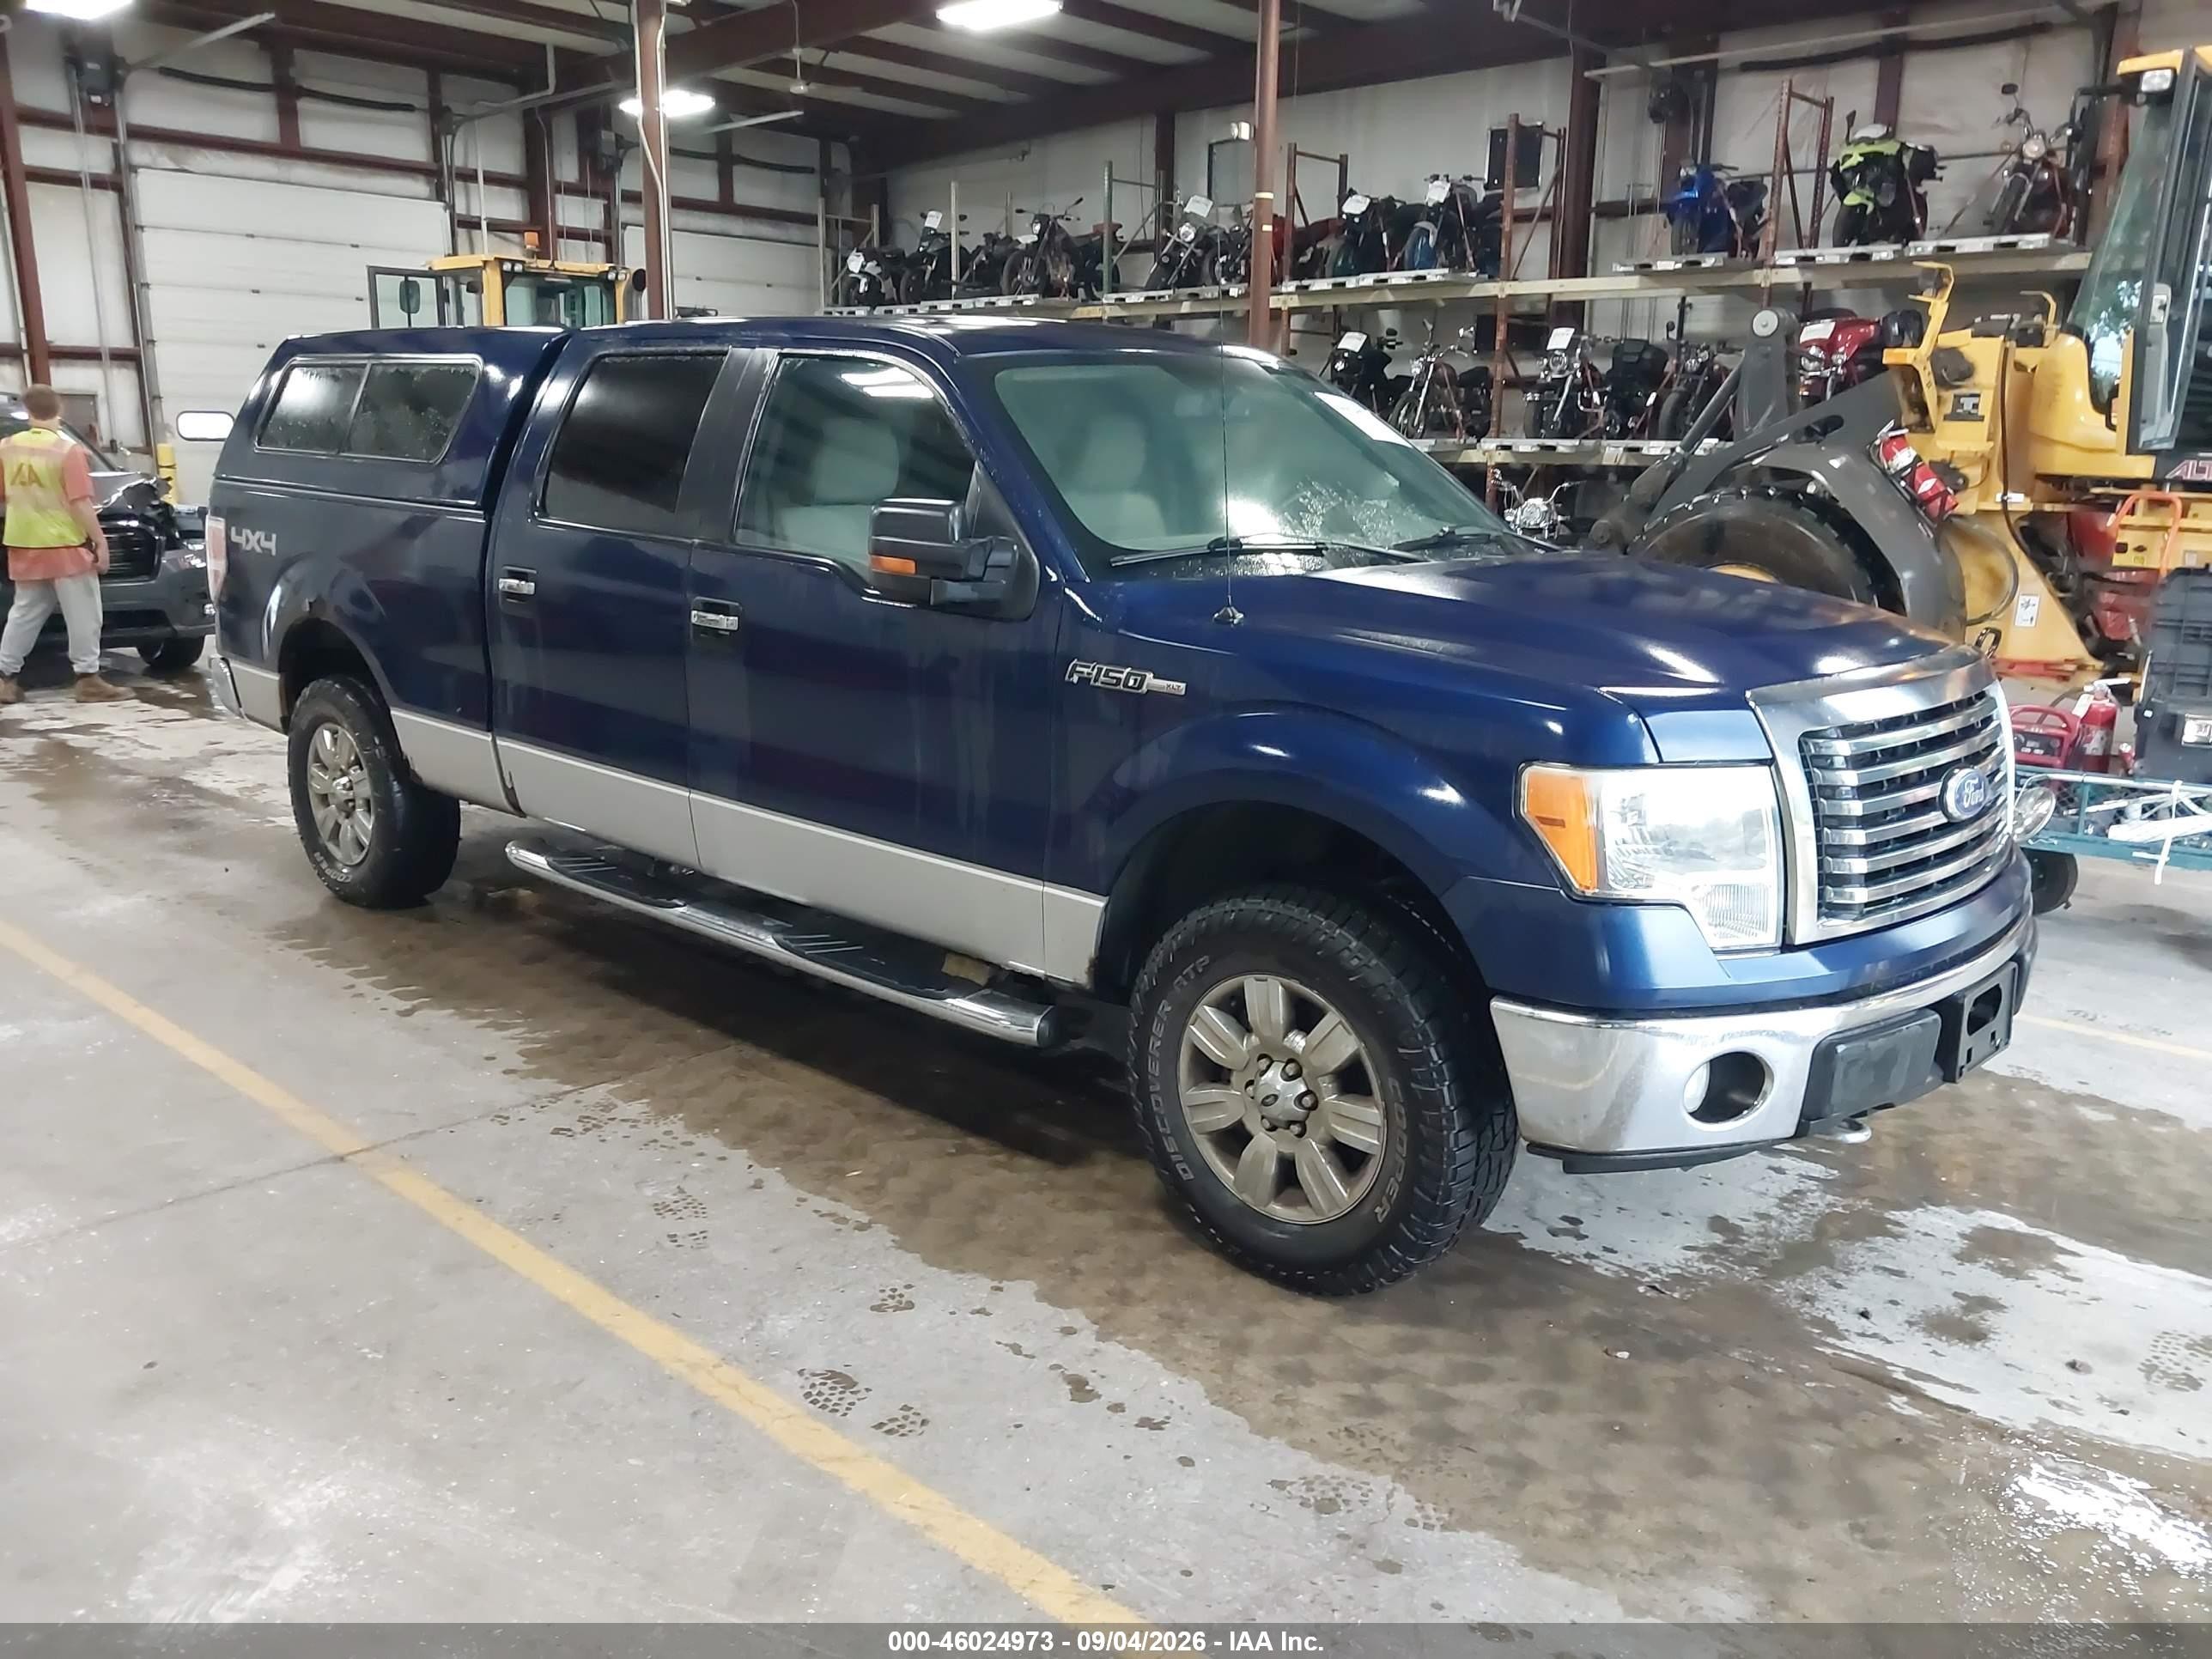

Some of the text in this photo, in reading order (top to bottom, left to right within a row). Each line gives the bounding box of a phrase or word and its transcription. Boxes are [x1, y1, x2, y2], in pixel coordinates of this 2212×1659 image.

[1165, 683, 1183, 693] XLT
[1147, 999, 1194, 1182] DISCOVERER
[1374, 1077, 1408, 1224] COOPER
